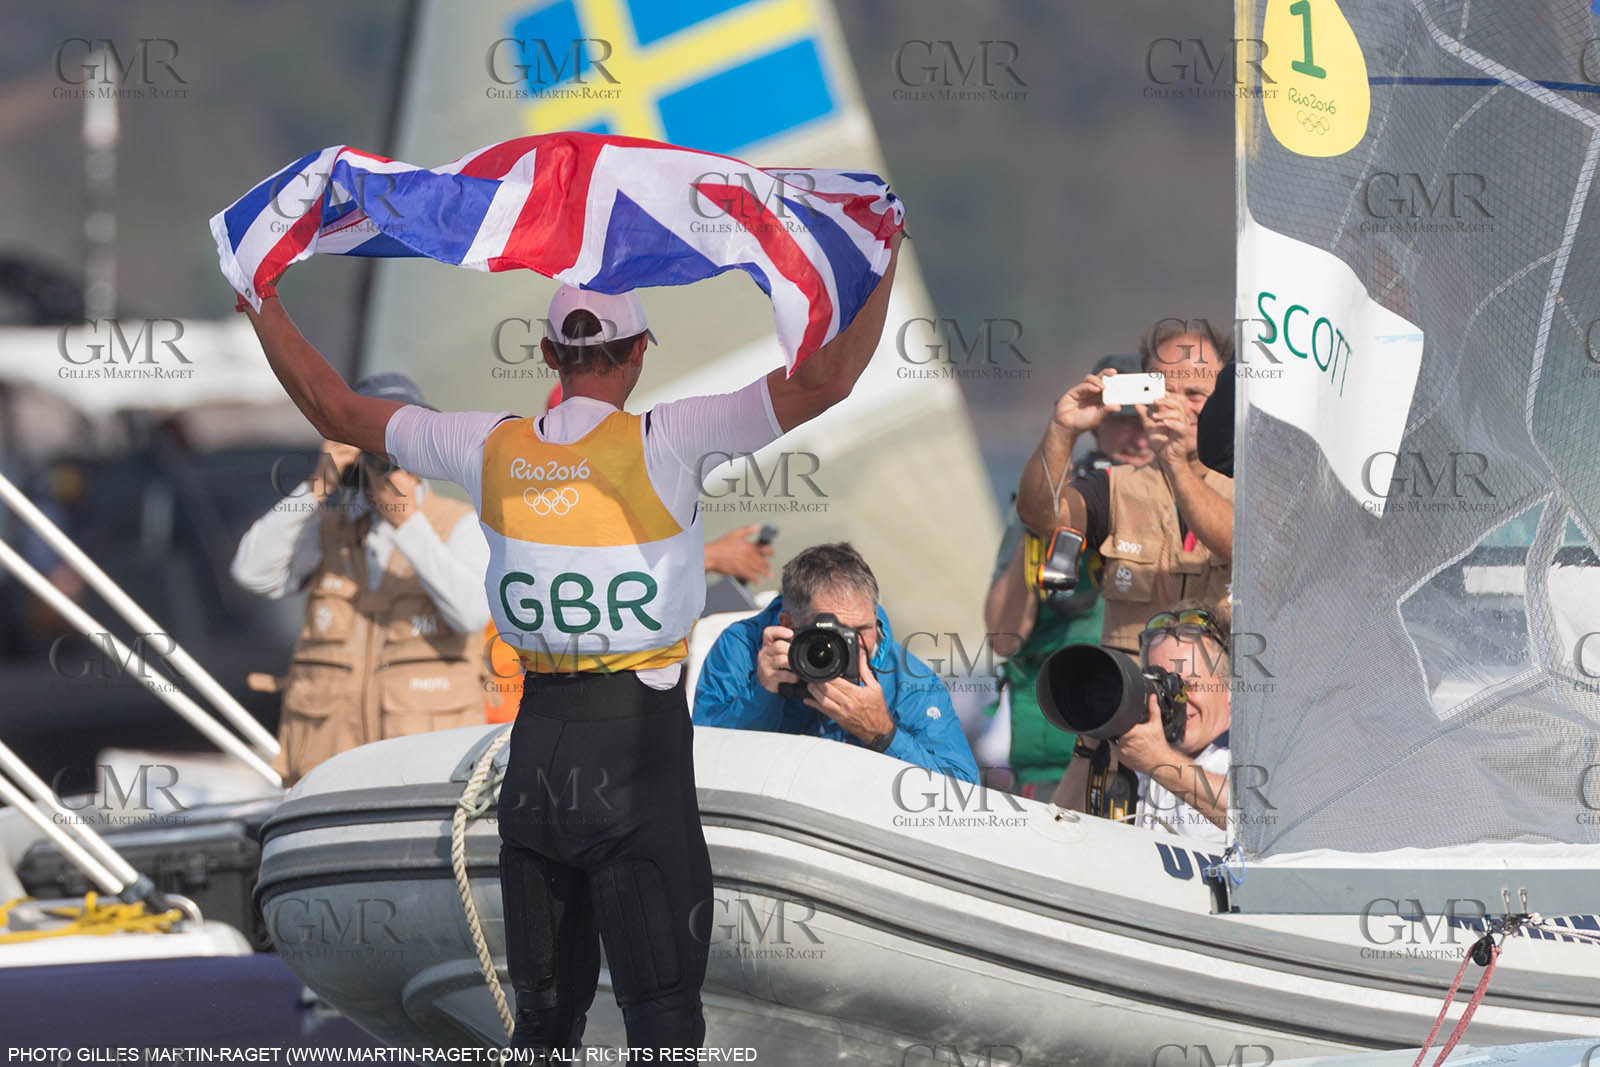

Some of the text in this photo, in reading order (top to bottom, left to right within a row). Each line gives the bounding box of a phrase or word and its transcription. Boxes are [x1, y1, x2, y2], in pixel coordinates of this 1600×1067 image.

[1290, 0, 1326, 79] 1
[1288, 87, 1336, 115] Rio2016
[1257, 291, 1352, 397] SCOTT
[510, 458, 591, 480] Rio2016
[499, 571, 662, 633] GBR
